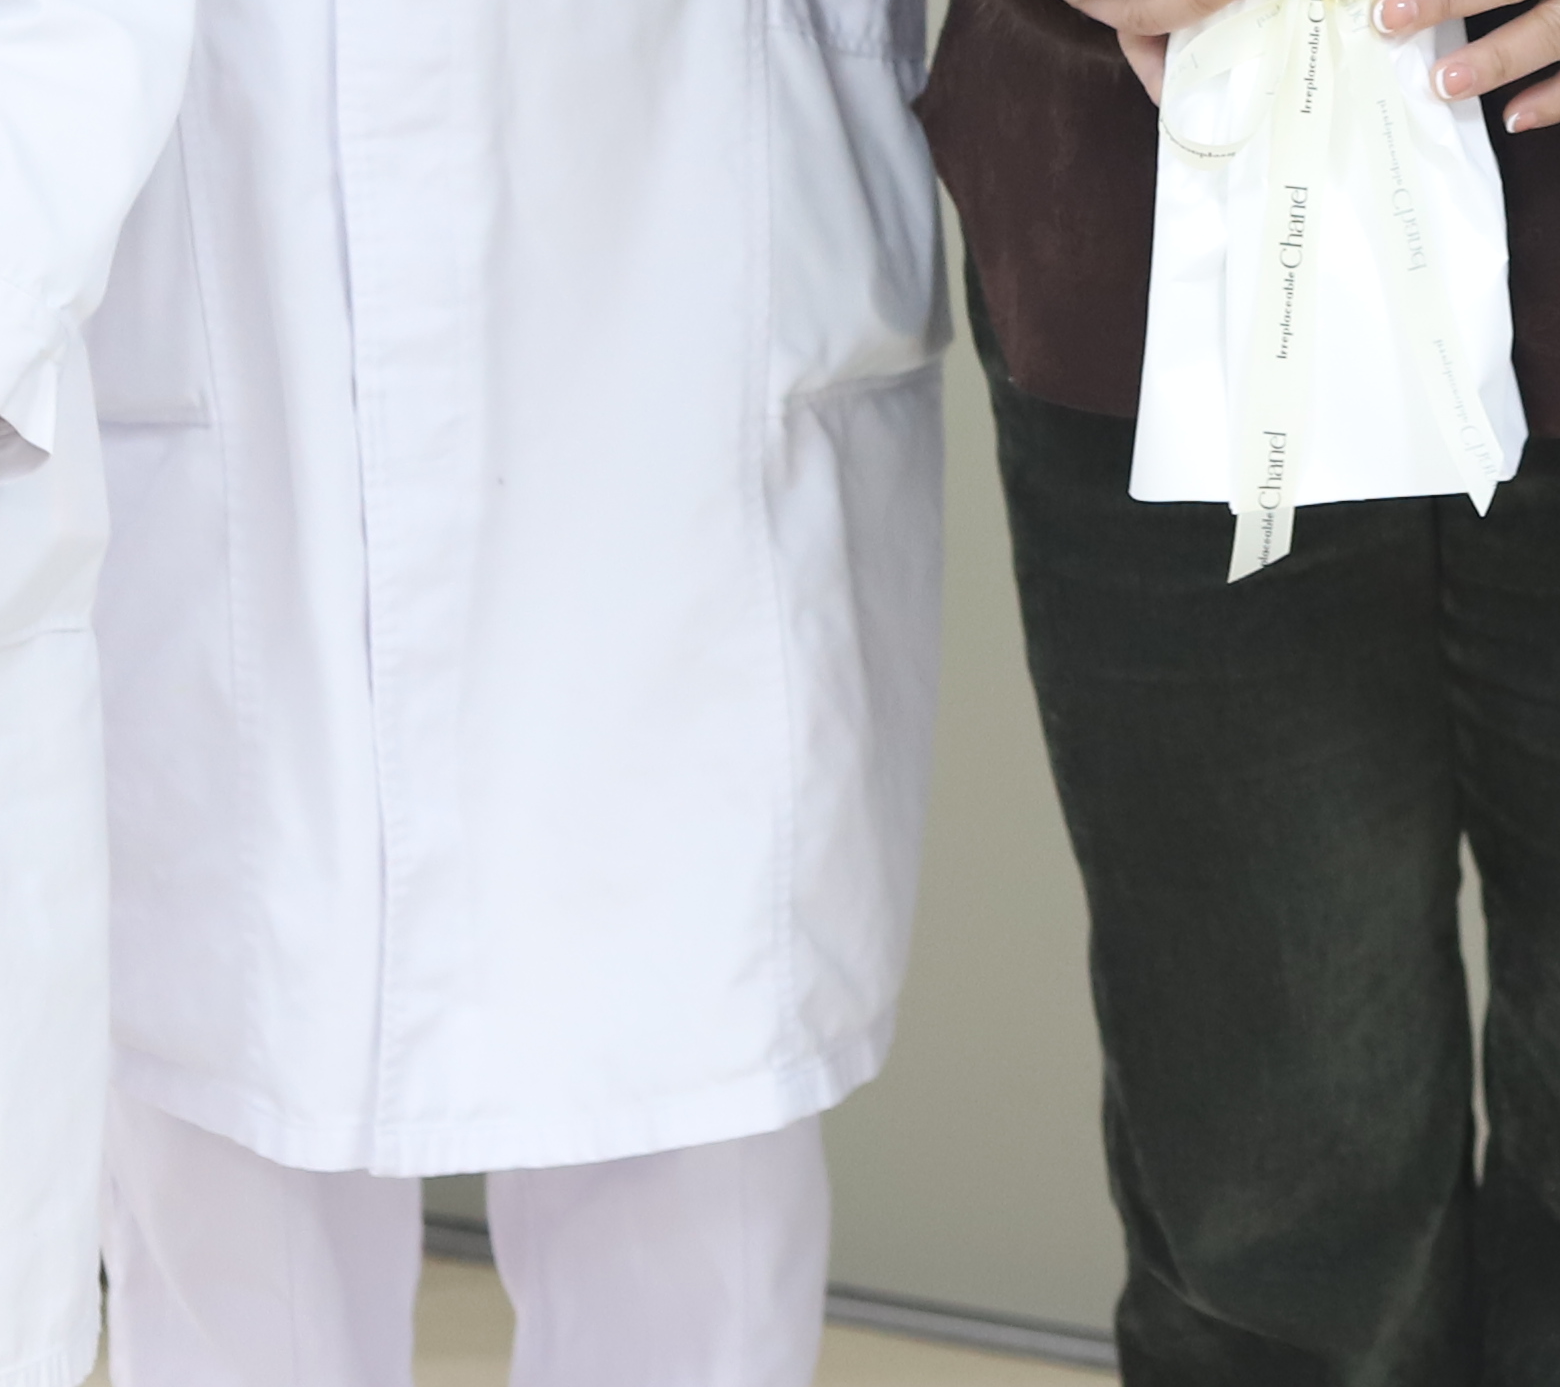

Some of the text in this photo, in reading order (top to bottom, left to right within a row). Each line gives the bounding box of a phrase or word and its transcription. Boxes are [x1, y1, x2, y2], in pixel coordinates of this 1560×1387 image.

[1299, 25, 1321, 115] Irreplaceable
[1276, 184, 1309, 360] Irreplaceable Chanel
[1257, 430, 1287, 510] Chanel
